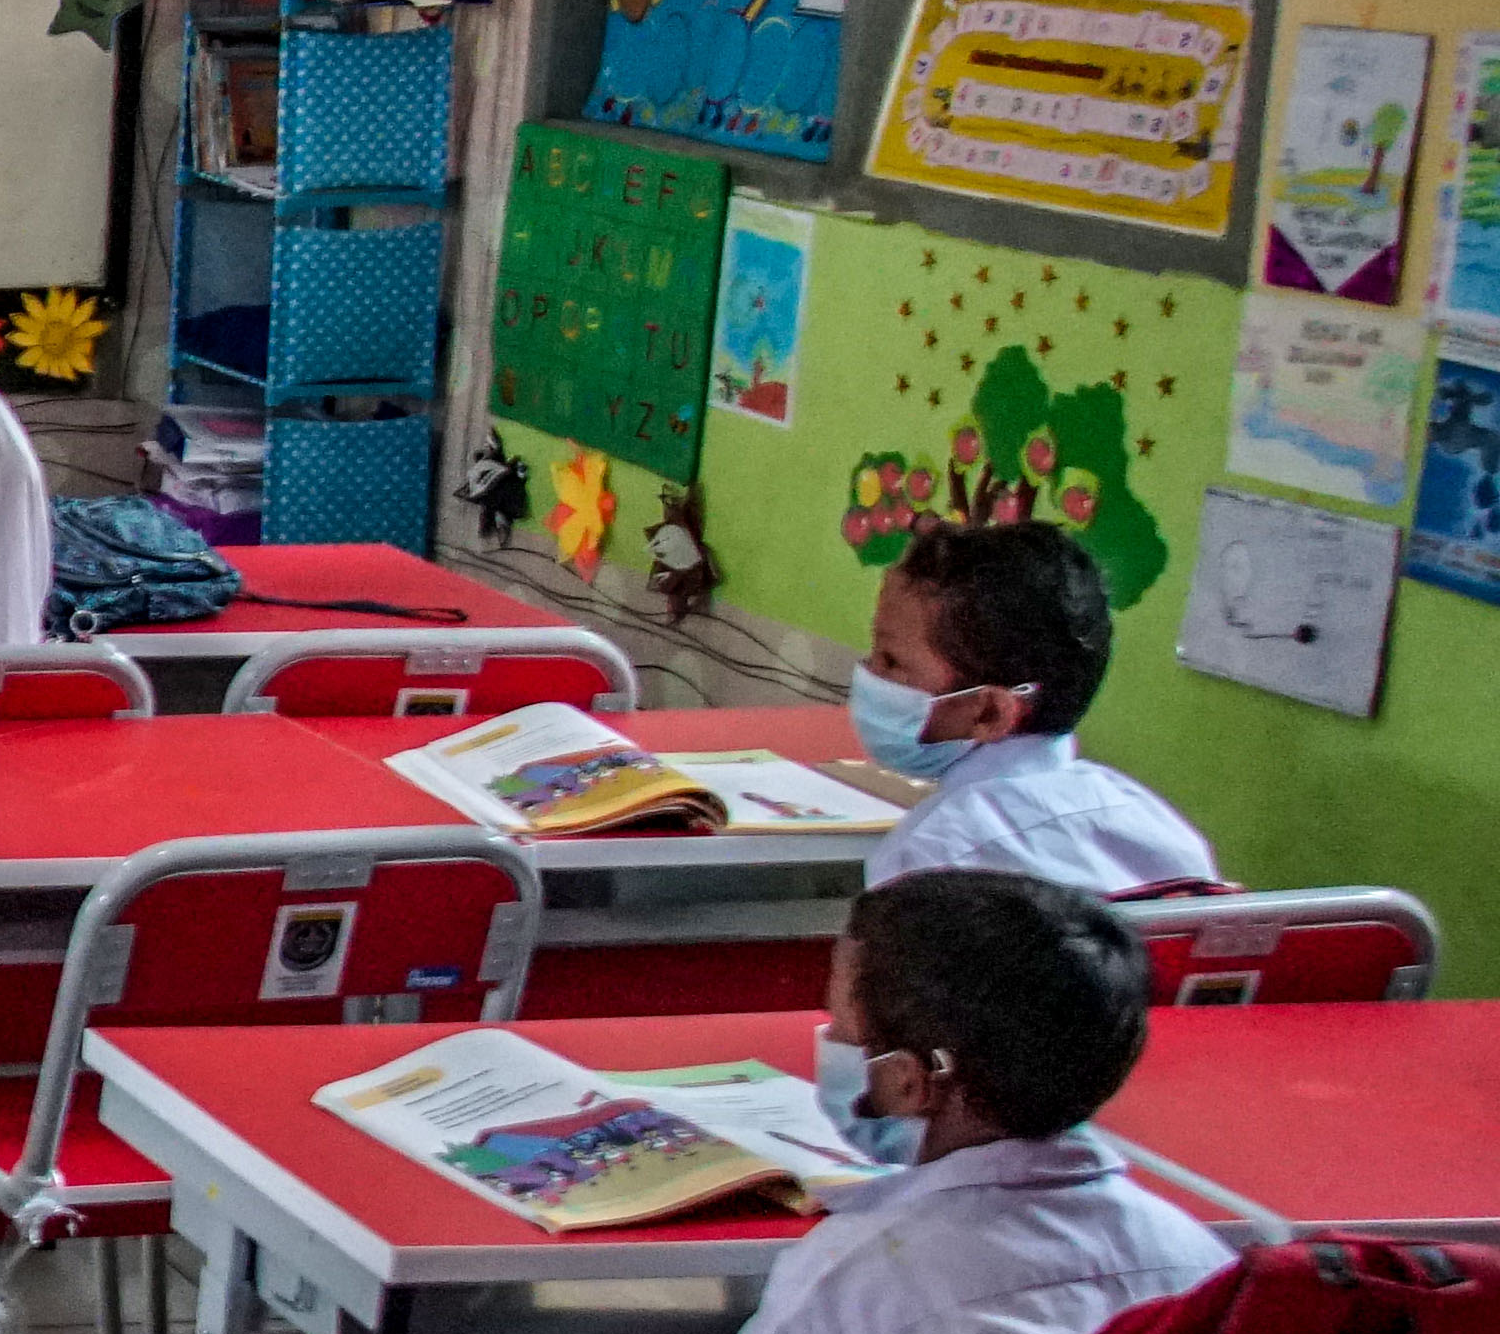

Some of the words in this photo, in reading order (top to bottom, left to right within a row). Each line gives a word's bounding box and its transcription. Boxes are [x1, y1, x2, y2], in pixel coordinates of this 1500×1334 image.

[623, 166, 645, 207] E
[657, 171, 678, 211] F
[643, 321, 661, 361] T
[671, 331, 691, 370] U
[635, 400, 655, 441] Z
